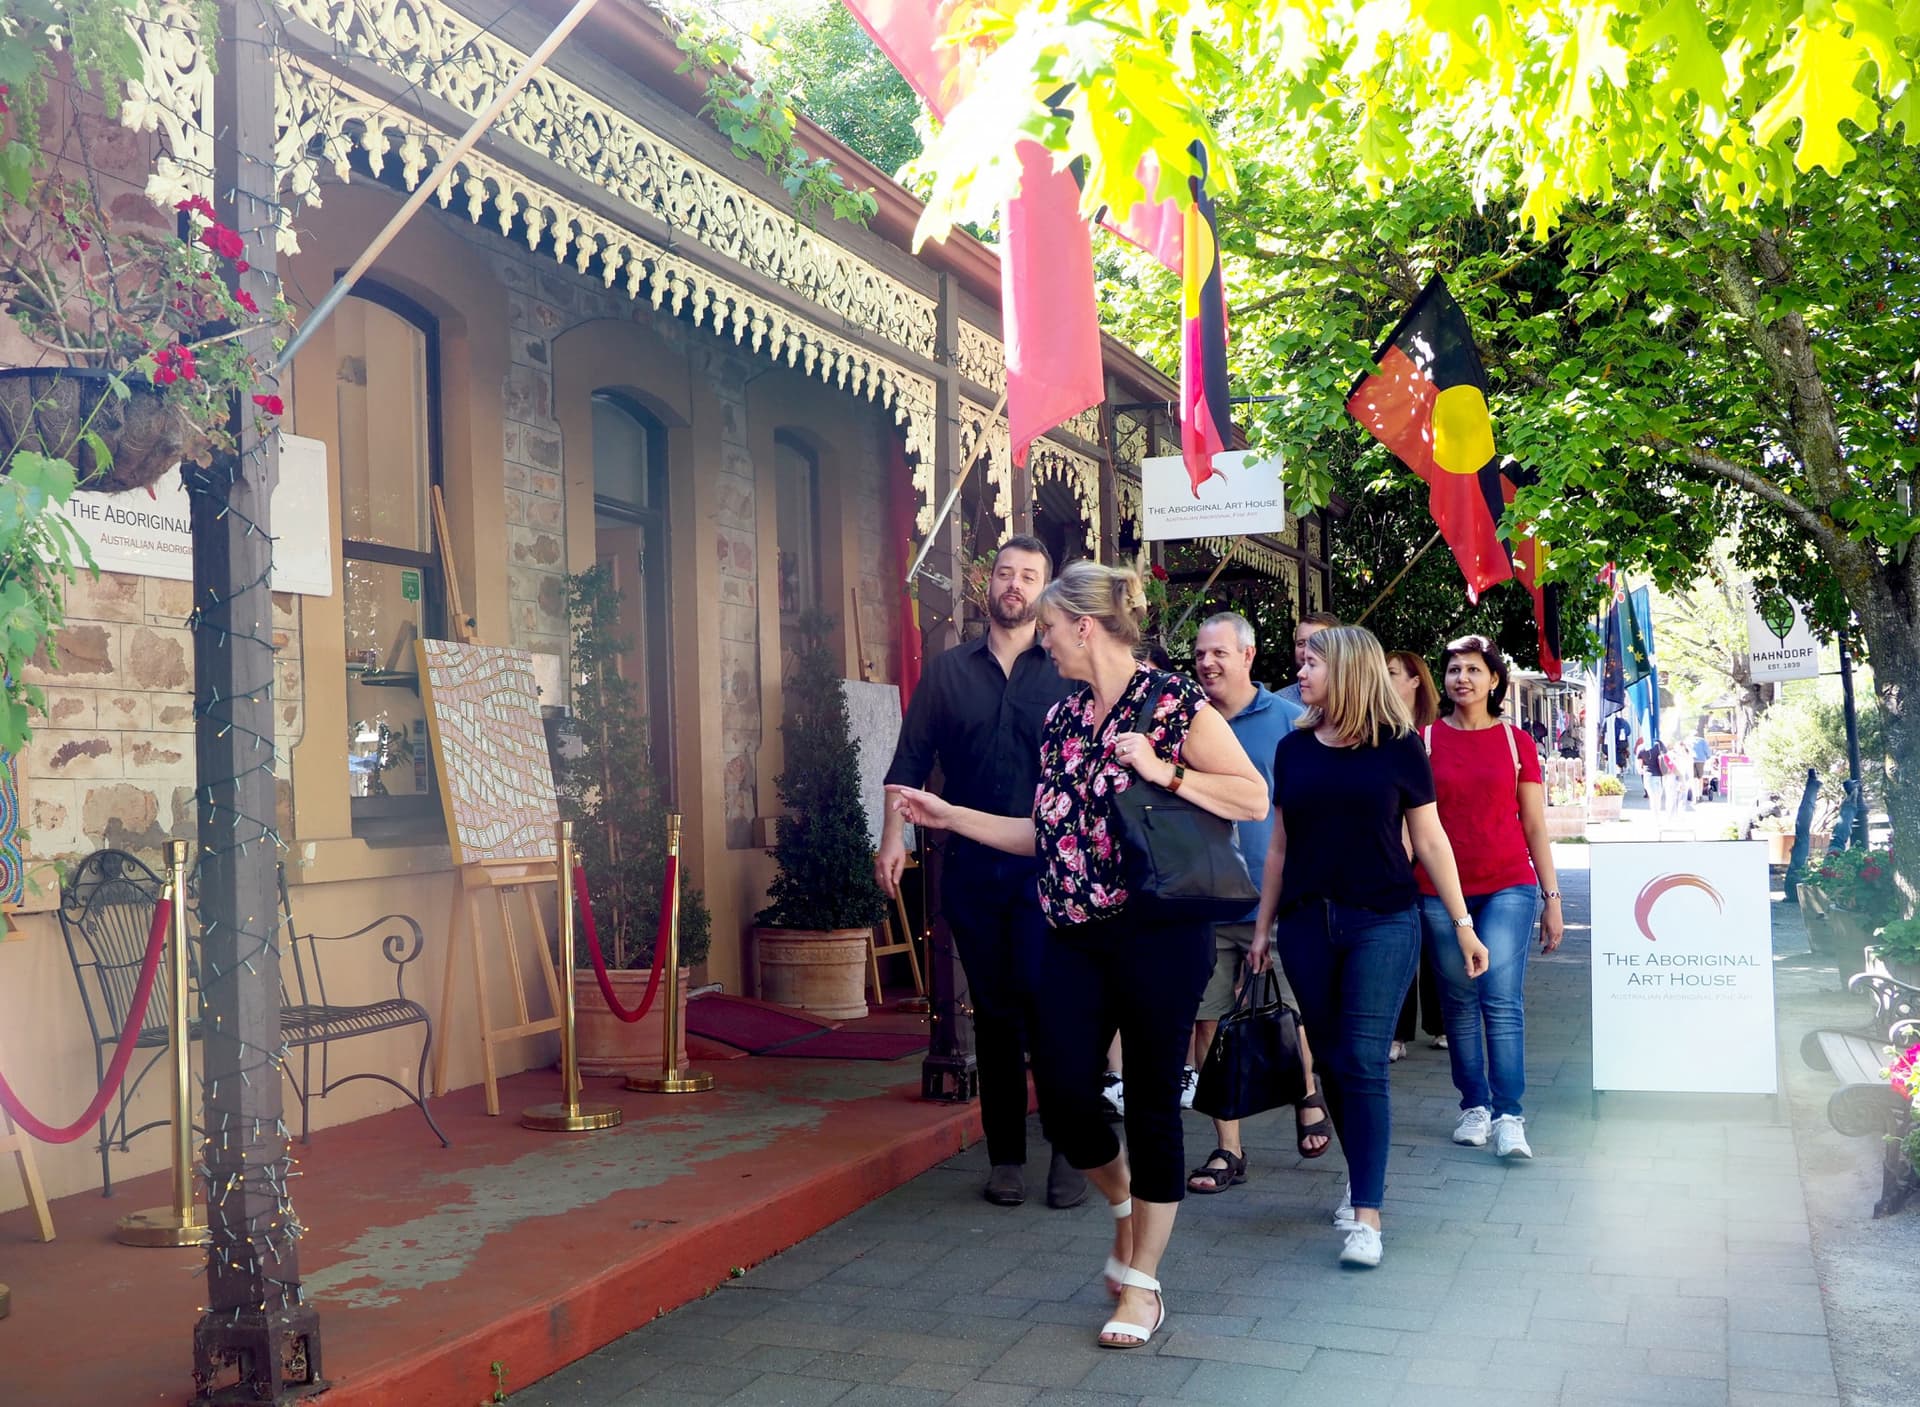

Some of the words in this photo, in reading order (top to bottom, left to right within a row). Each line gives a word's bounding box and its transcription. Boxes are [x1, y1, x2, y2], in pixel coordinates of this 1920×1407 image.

[1168, 504, 1221, 513] ABORIGINAL
[1225, 501, 1242, 509] ART
[1246, 500, 1277, 508] HOUSE
[69, 498, 100, 520] THE
[104, 504, 192, 534] ABORIGINAL
[100, 533, 154, 550] AUSTRALIAN
[1753, 648, 1813, 662] HAHNDORF
[1603, 953, 1640, 966] THE
[1646, 953, 1760, 966] ABORIGINAL
[1627, 972, 1664, 986] ART
[1670, 973, 1736, 986] HOUSE
